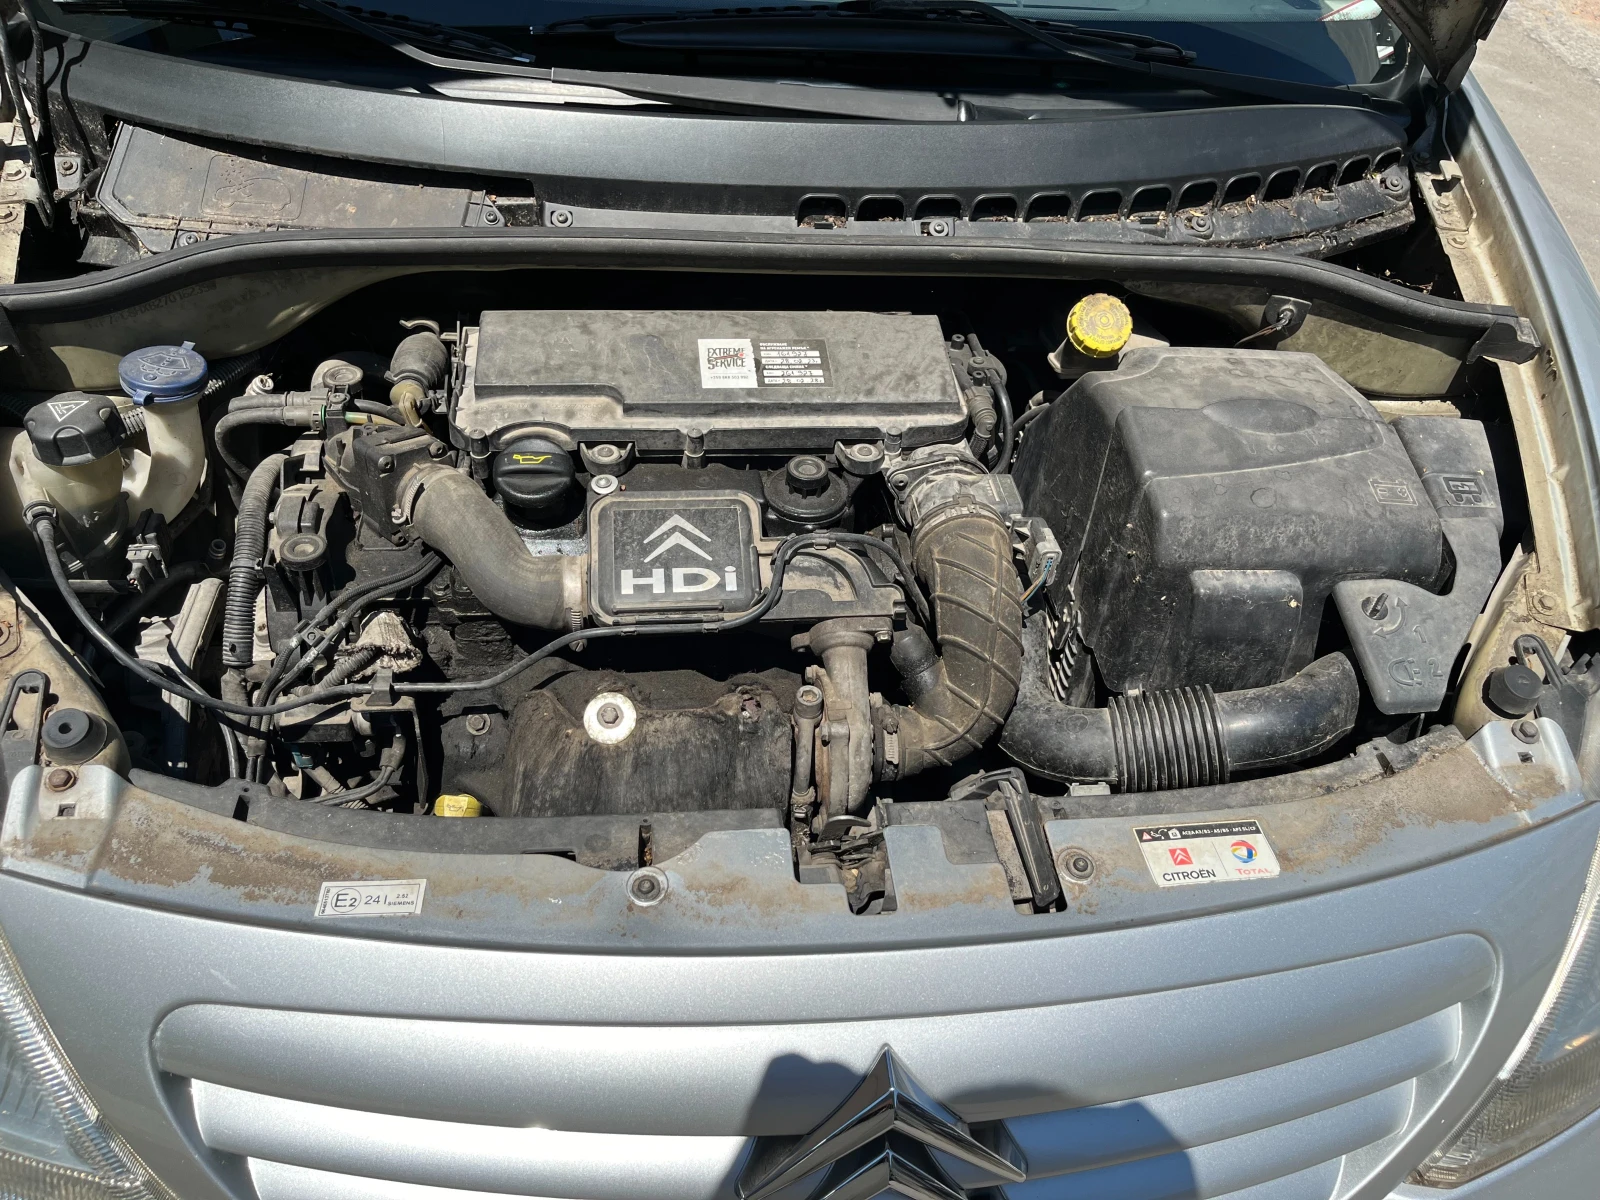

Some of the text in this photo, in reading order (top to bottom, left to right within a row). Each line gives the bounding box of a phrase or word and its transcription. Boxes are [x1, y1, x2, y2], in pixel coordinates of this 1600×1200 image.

[707, 347, 745, 358] EXTREME
[707, 357, 746, 370] SERVICE
[620, 565, 738, 595] HDi
[1413, 625, 1427, 643] 1
[1428, 658, 1443, 676] 2
[334, 893, 358, 908] E2
[364, 894, 381, 905] 24
